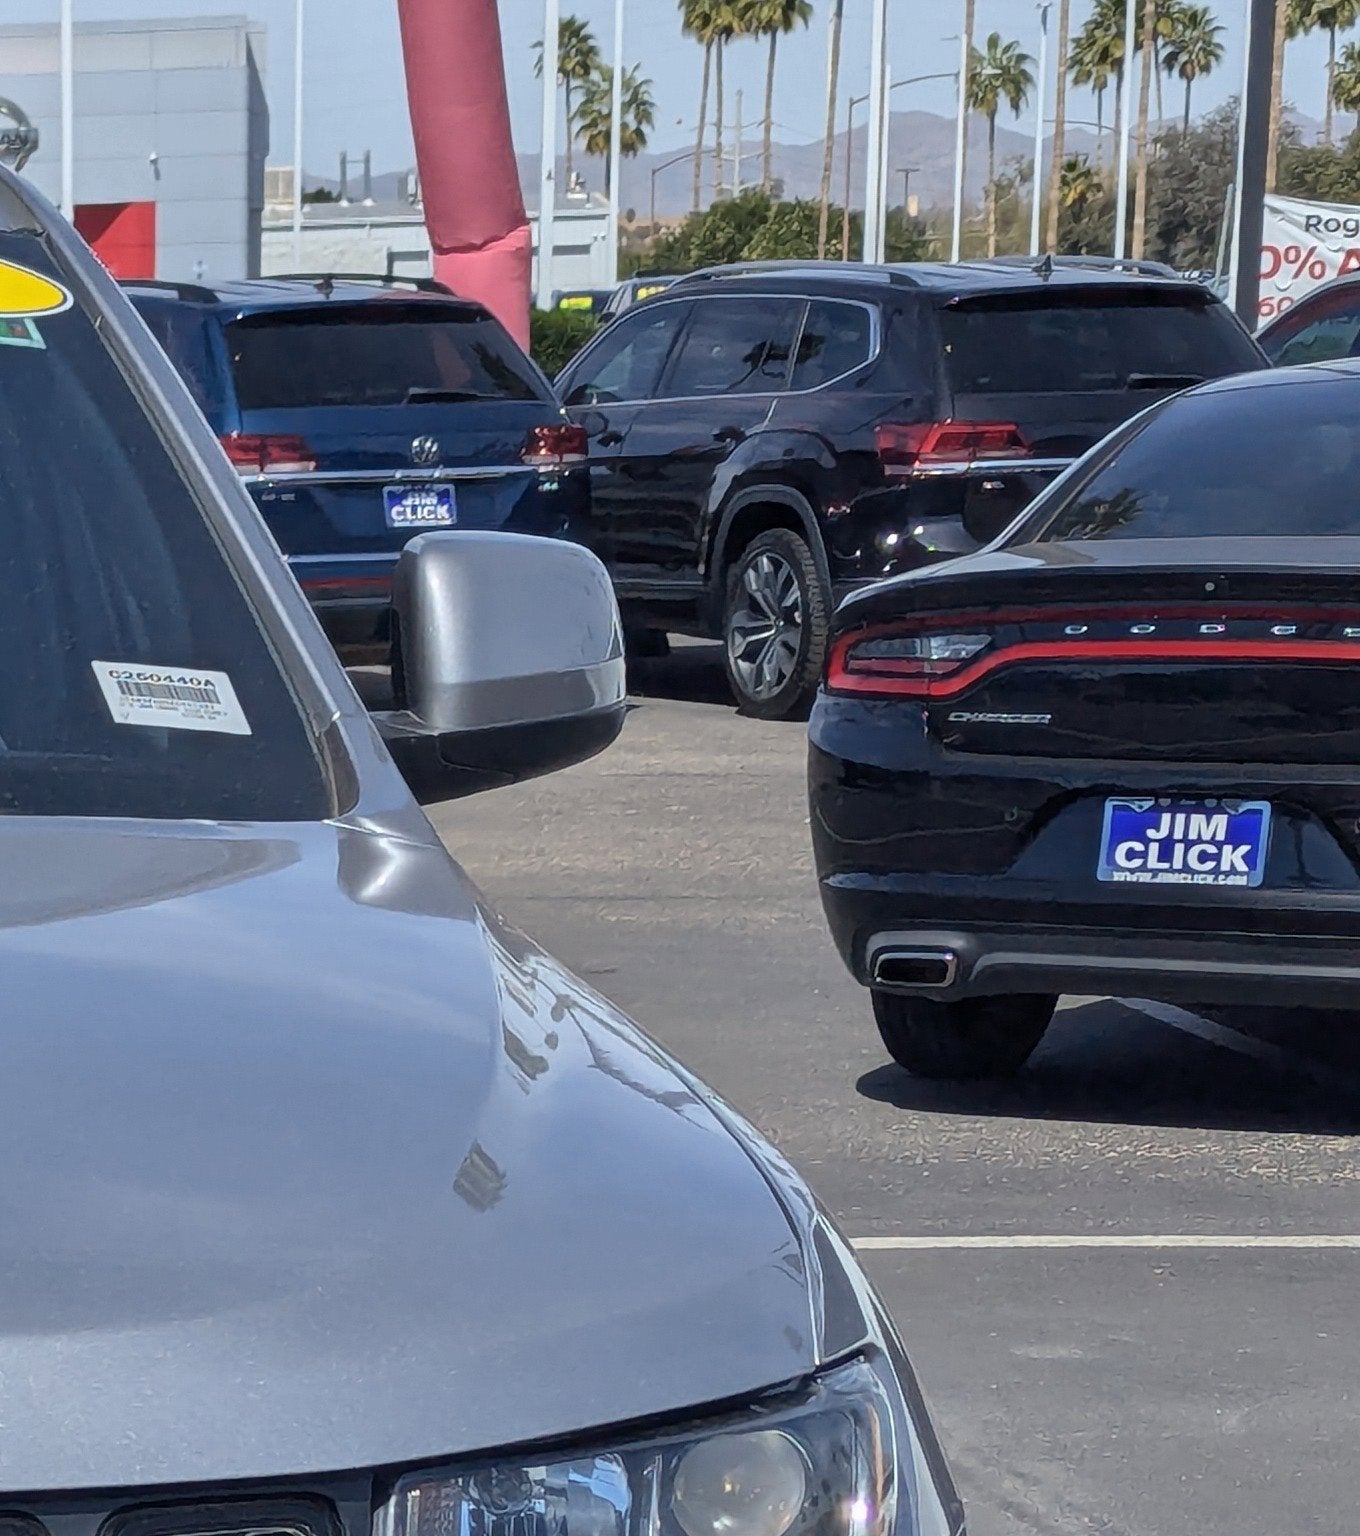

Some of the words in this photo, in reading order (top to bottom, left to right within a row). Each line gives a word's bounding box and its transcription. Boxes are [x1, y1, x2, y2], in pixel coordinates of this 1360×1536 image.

[1304, 214, 1360, 238] Rog
[391, 504, 450, 520] CLICK
[1146, 812, 1229, 841] JIM
[1114, 840, 1251, 872] CLICK
